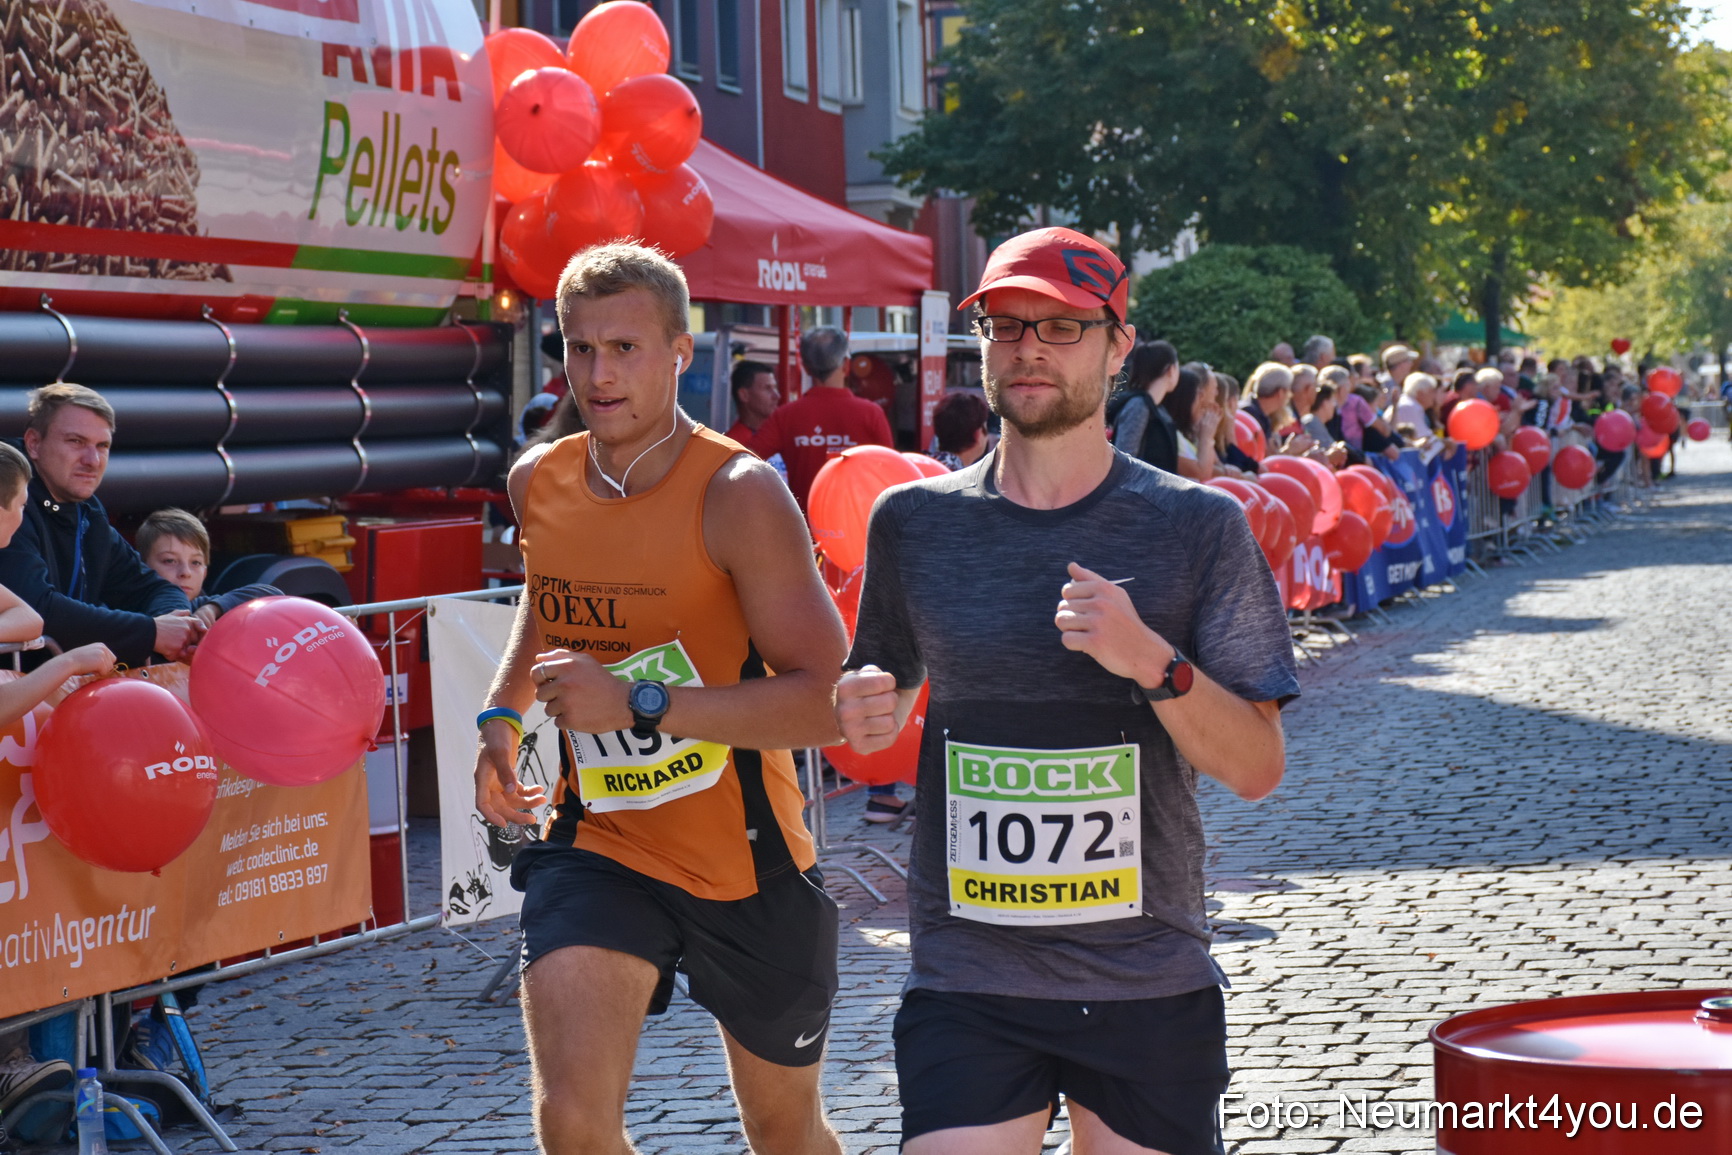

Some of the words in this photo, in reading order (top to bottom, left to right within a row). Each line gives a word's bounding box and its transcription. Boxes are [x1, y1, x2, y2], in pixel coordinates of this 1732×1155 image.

[308, 100, 460, 235] Pellets
[574, 585, 602, 594] UHREN
[604, 586, 622, 595] UND
[623, 587, 667, 596] SCHMUCK
[546, 634, 572, 648] CIBA
[587, 639, 631, 652] VISION
[591, 727, 686, 757] 119
[604, 752, 704, 793] RICHARD
[958, 752, 1122, 796] BOCK
[219, 828, 249, 853] Melden
[248, 823, 261, 843] Sie
[262, 816, 282, 839] sich
[284, 813, 301, 834] bei
[303, 812, 328, 830] uns:
[969, 811, 1115, 864] 1072
[226, 853, 246, 877] web:
[246, 838, 319, 871] codeclinic.de
[218, 885, 234, 907] tel:
[234, 876, 267, 902] 09181
[269, 869, 305, 894] 8833
[306, 863, 328, 886] 897
[965, 878, 1120, 904] CHRISTIAN
